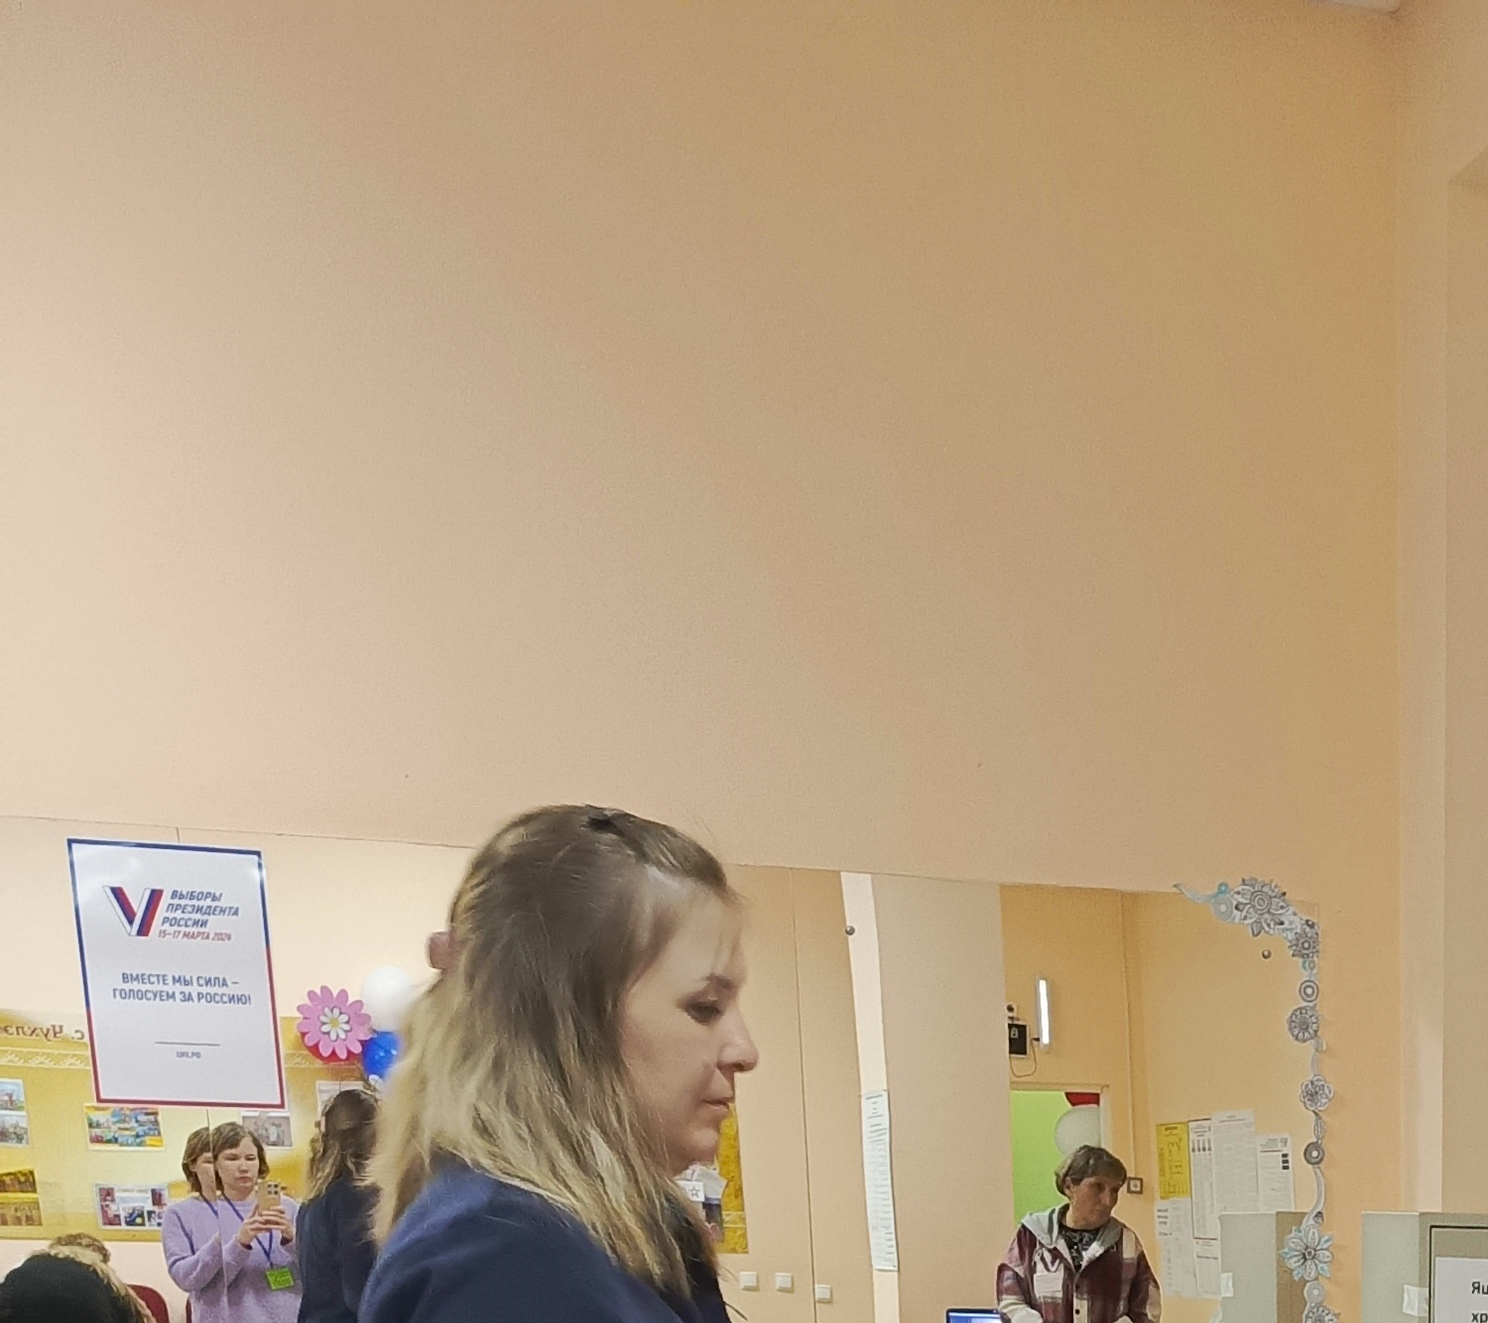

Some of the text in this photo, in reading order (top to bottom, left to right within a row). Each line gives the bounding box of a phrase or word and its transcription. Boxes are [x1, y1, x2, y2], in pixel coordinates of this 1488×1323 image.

[170, 890, 223, 902] ВЫБОРЫ
[166, 903, 239, 917] ПРЕЗИДЕНТА
[161, 916, 208, 928] РОССИИ
[182, 931, 209, 941] МАРТА
[211, 932, 232, 942] 2024
[122, 972, 169, 985] ВМЕСТЕ
[172, 975, 193, 987] МЫ
[197, 976, 229, 988] СИЛА
[113, 988, 252, 1005] ГОЛОСУЕМ ЗА РОССИЮ!
